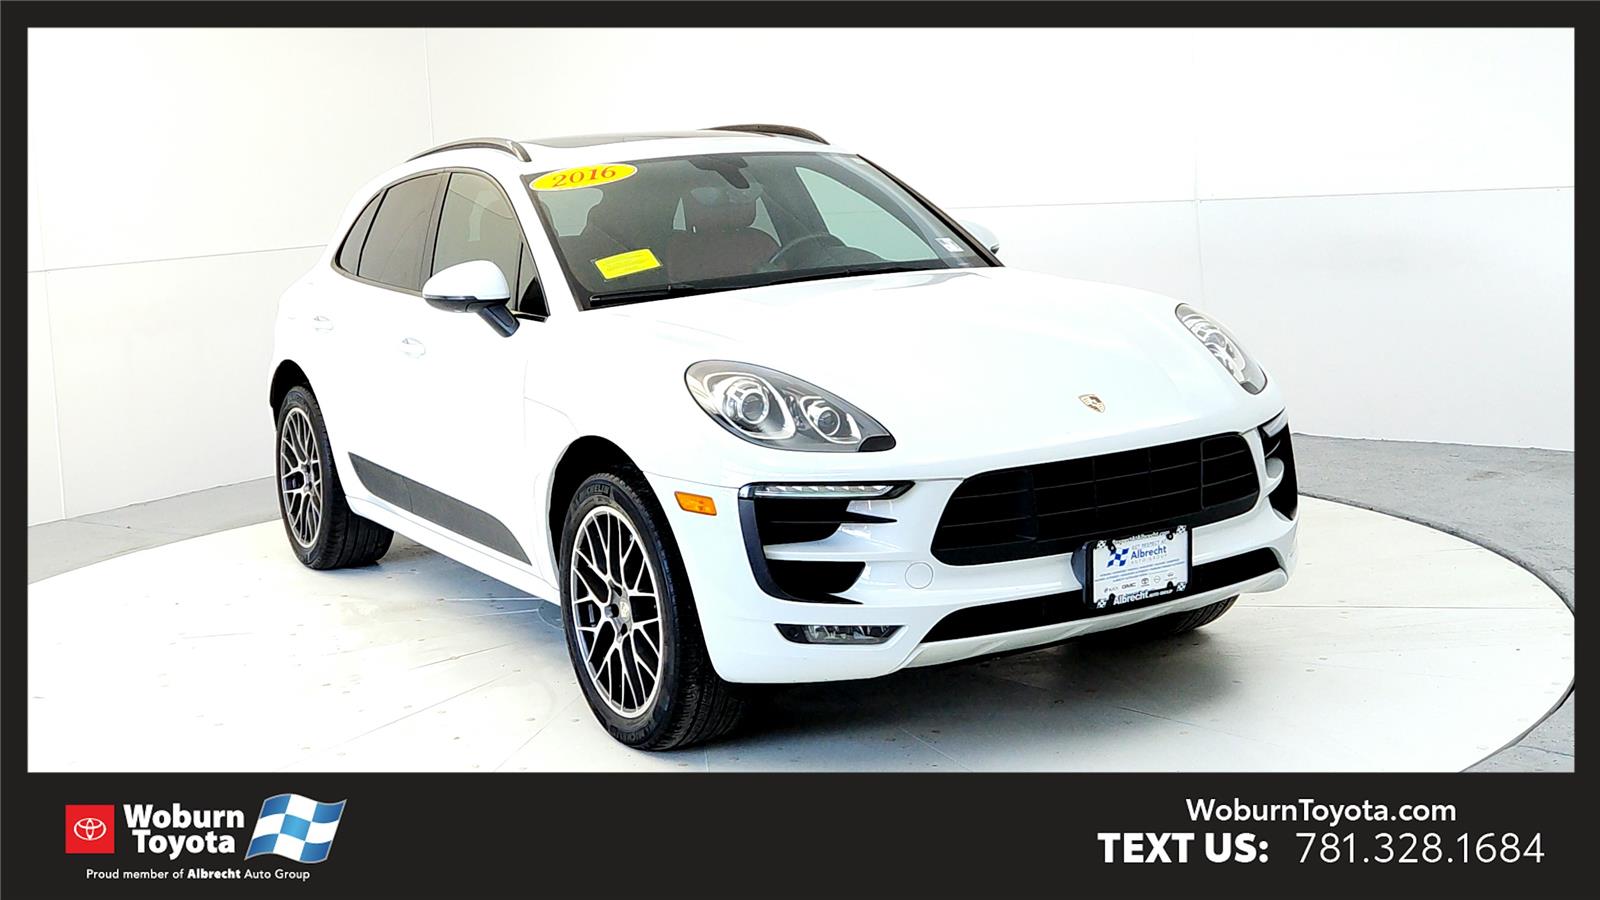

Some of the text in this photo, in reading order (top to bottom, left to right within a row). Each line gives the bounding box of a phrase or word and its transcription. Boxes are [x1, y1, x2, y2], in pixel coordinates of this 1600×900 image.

[553, 165, 617, 187] 2016
[1131, 545, 1167, 559] Albrecht
[1113, 590, 1149, 605] Albrecht
